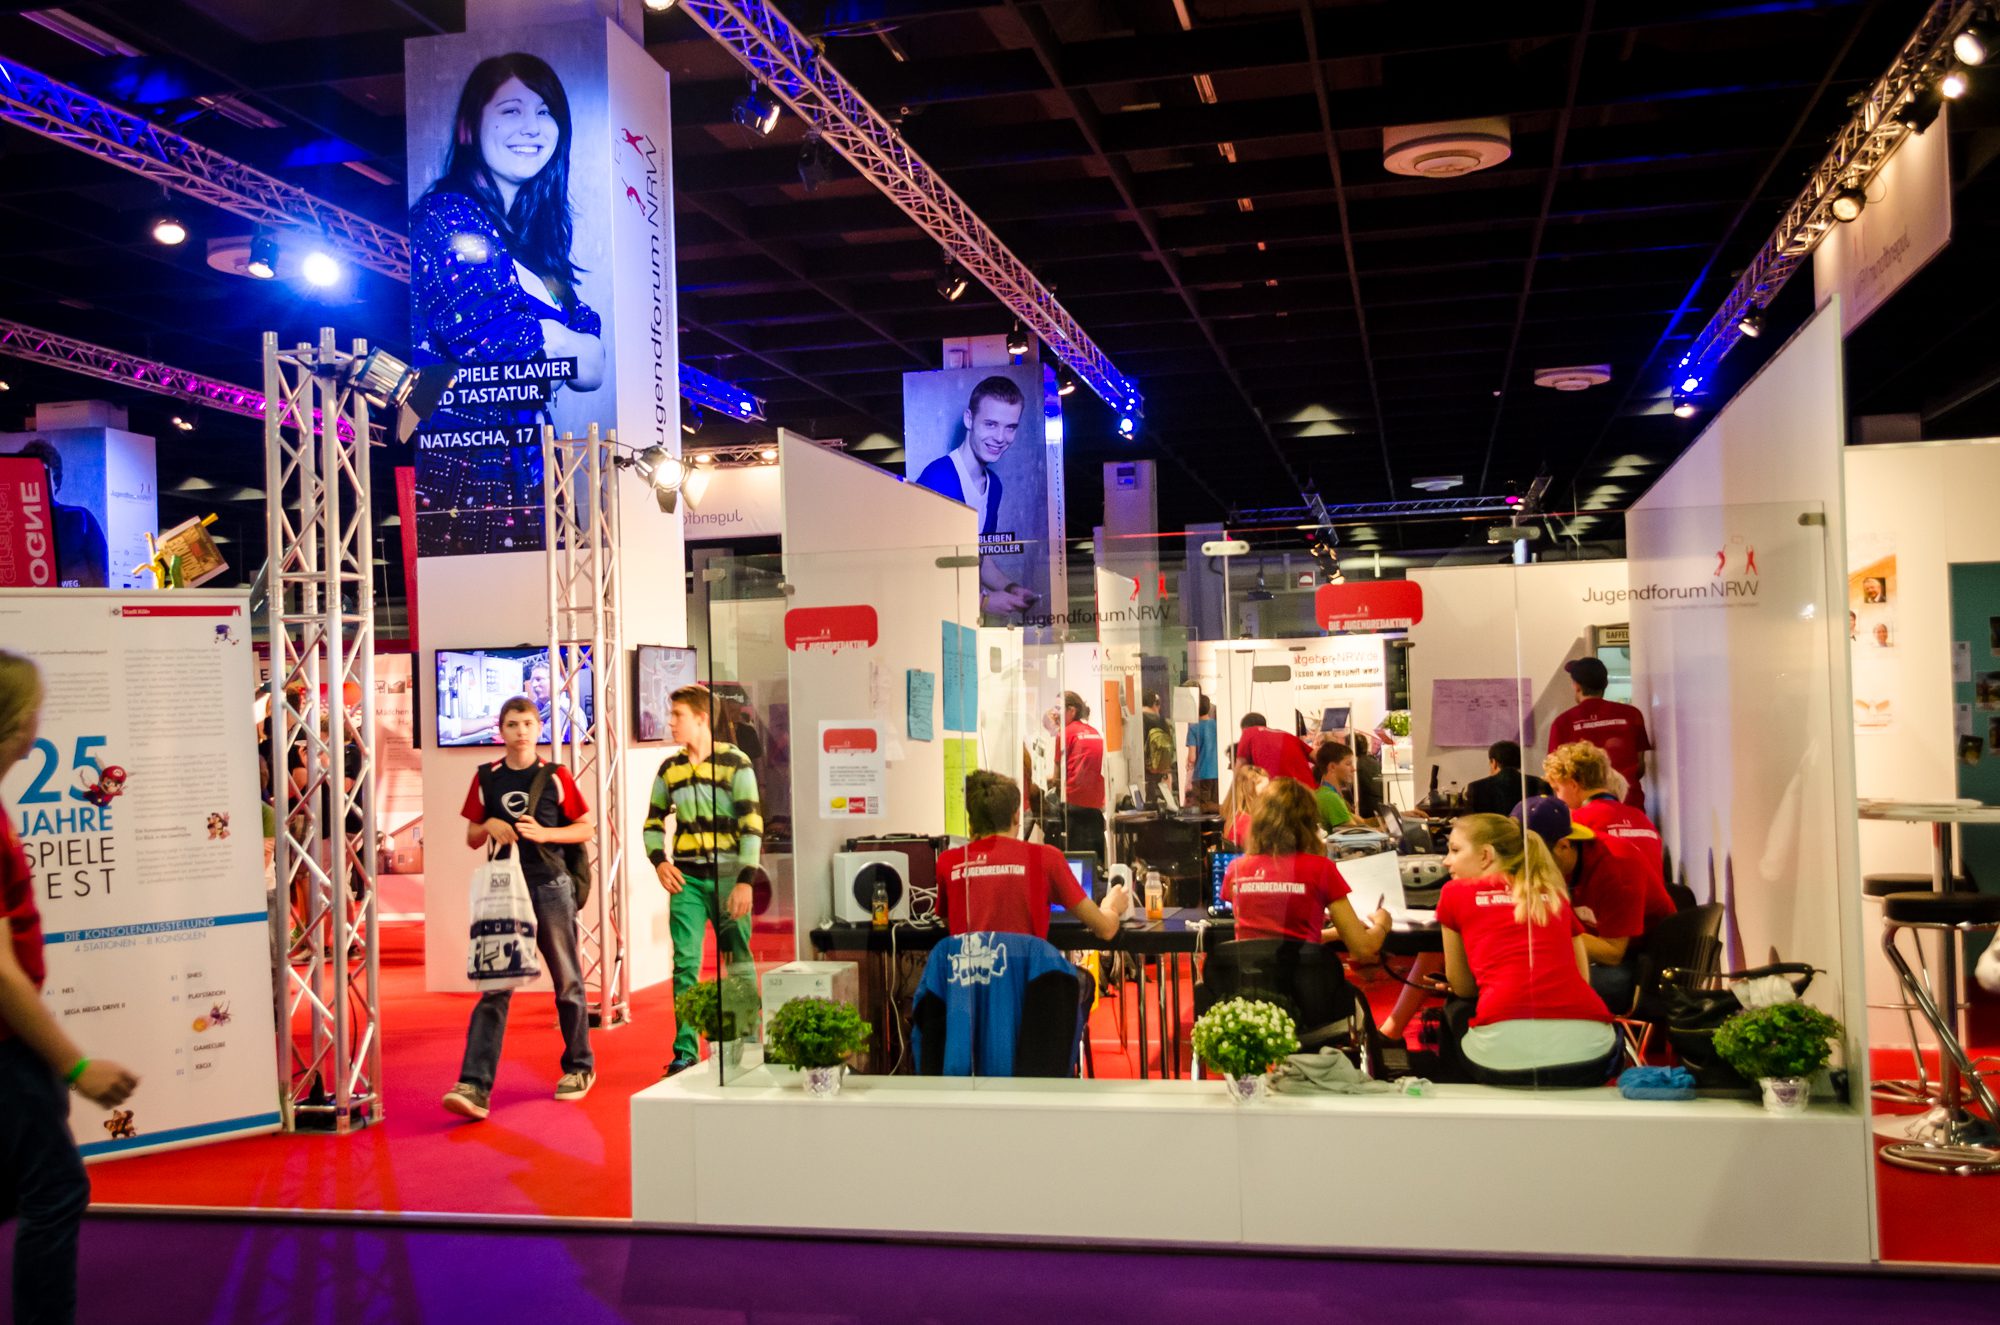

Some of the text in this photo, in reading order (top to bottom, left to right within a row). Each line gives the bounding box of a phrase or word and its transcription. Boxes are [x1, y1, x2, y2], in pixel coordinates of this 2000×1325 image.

[646, 134, 667, 447] ugendforum NRW
[504, 361, 571, 380] KLAVIER
[459, 385, 544, 404] TASTATUR.
[420, 428, 534, 450] NATASCHA, 17
[17, 735, 107, 805] 25
[19, 805, 113, 838] JAHRE
[23, 837, 116, 869] SPIELE
[28, 868, 116, 900] EST
[64, 917, 216, 943] DIE KONSOLENAUSSTELLUNG
[83, 939, 137, 952] STATIONEN
[64, 1008, 81, 1016] SEGA
[82, 1006, 101, 1014] MEGA
[102, 1003, 120, 1011] DRIVE
